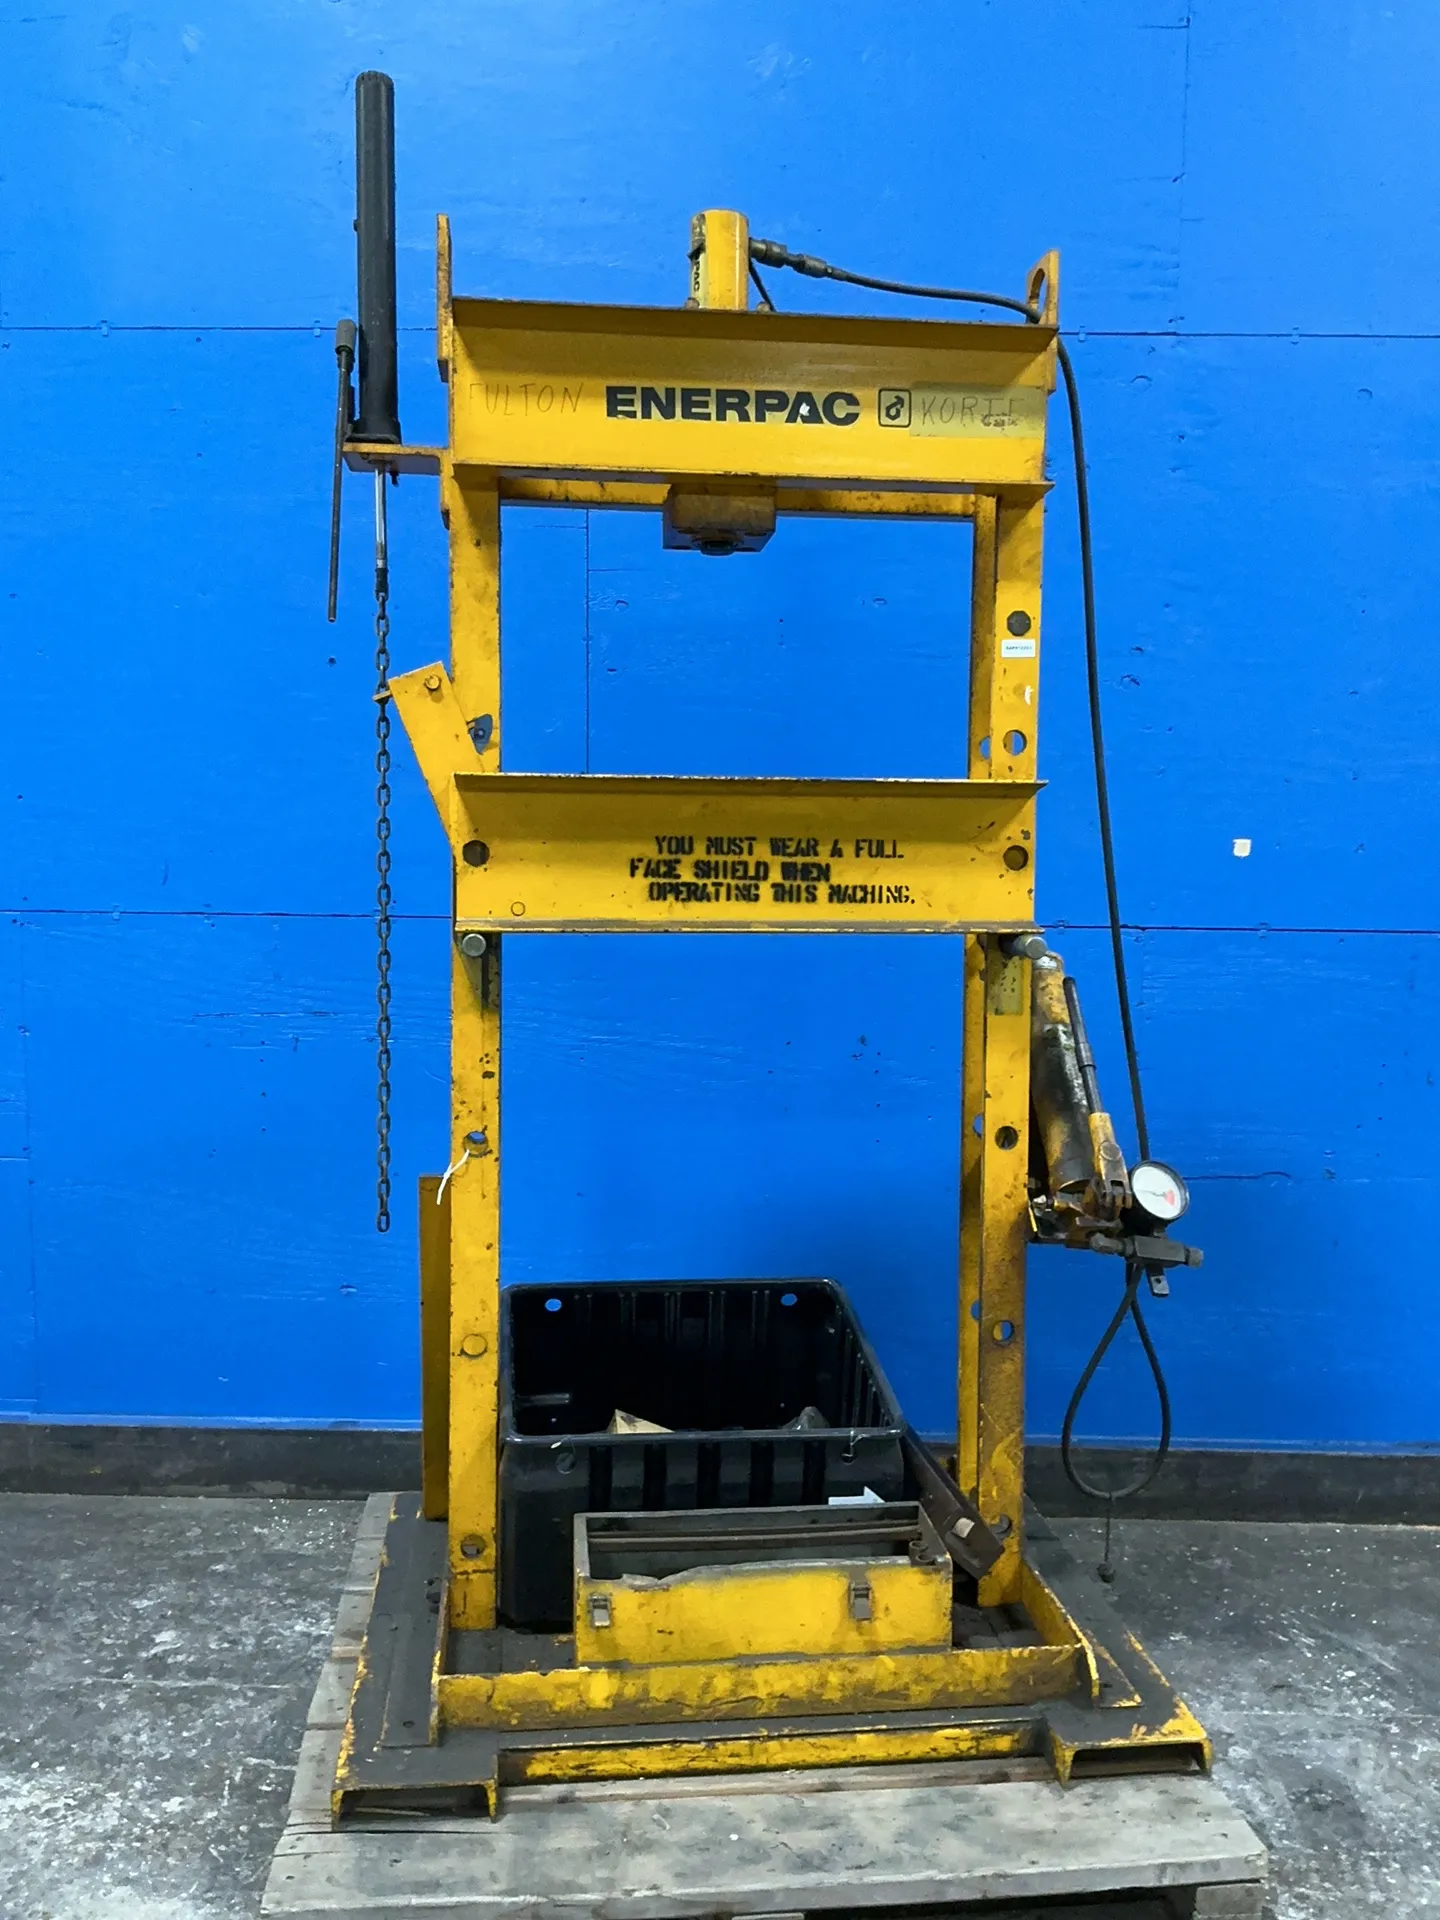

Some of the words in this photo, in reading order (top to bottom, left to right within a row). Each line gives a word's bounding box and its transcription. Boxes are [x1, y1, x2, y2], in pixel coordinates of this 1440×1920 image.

[605, 385, 861, 427] ENERPAC
[655, 835, 694, 856] YOU
[706, 836, 757, 856] MUST
[769, 837, 819, 857] WEAR
[829, 838, 844, 858] A
[854, 838, 904, 859] FULL
[630, 857, 682, 879] FACE
[693, 859, 770, 881] SHIELD
[781, 861, 831, 883] WHEN
[649, 881, 761, 902] OPERATING
[770, 882, 818, 904] THIS
